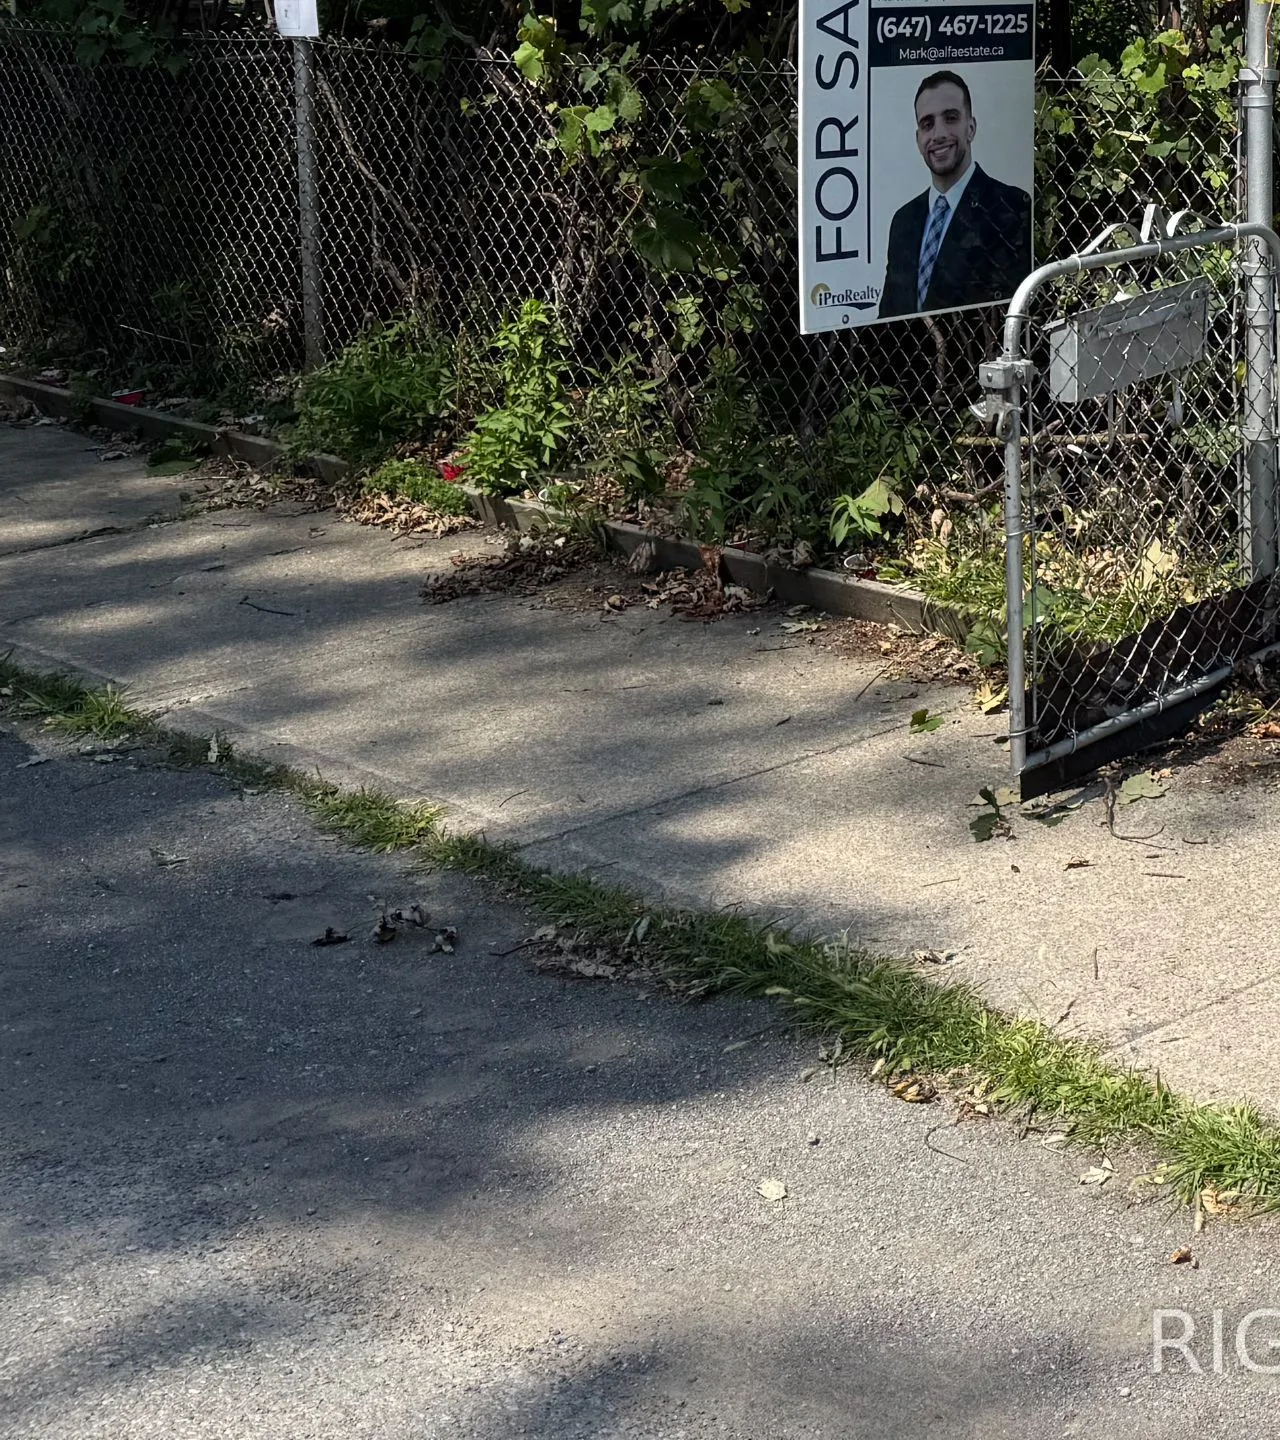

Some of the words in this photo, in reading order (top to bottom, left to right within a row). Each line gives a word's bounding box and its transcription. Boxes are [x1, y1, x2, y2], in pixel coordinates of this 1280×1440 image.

[876, 15, 932, 44] (647)
[938, 13, 1028, 36] 467-1225
[899, 45, 1005, 61] Mark@alfaestate.ca
[815, 114, 859, 263] FOR
[818, 285, 882, 306] iProRealty
